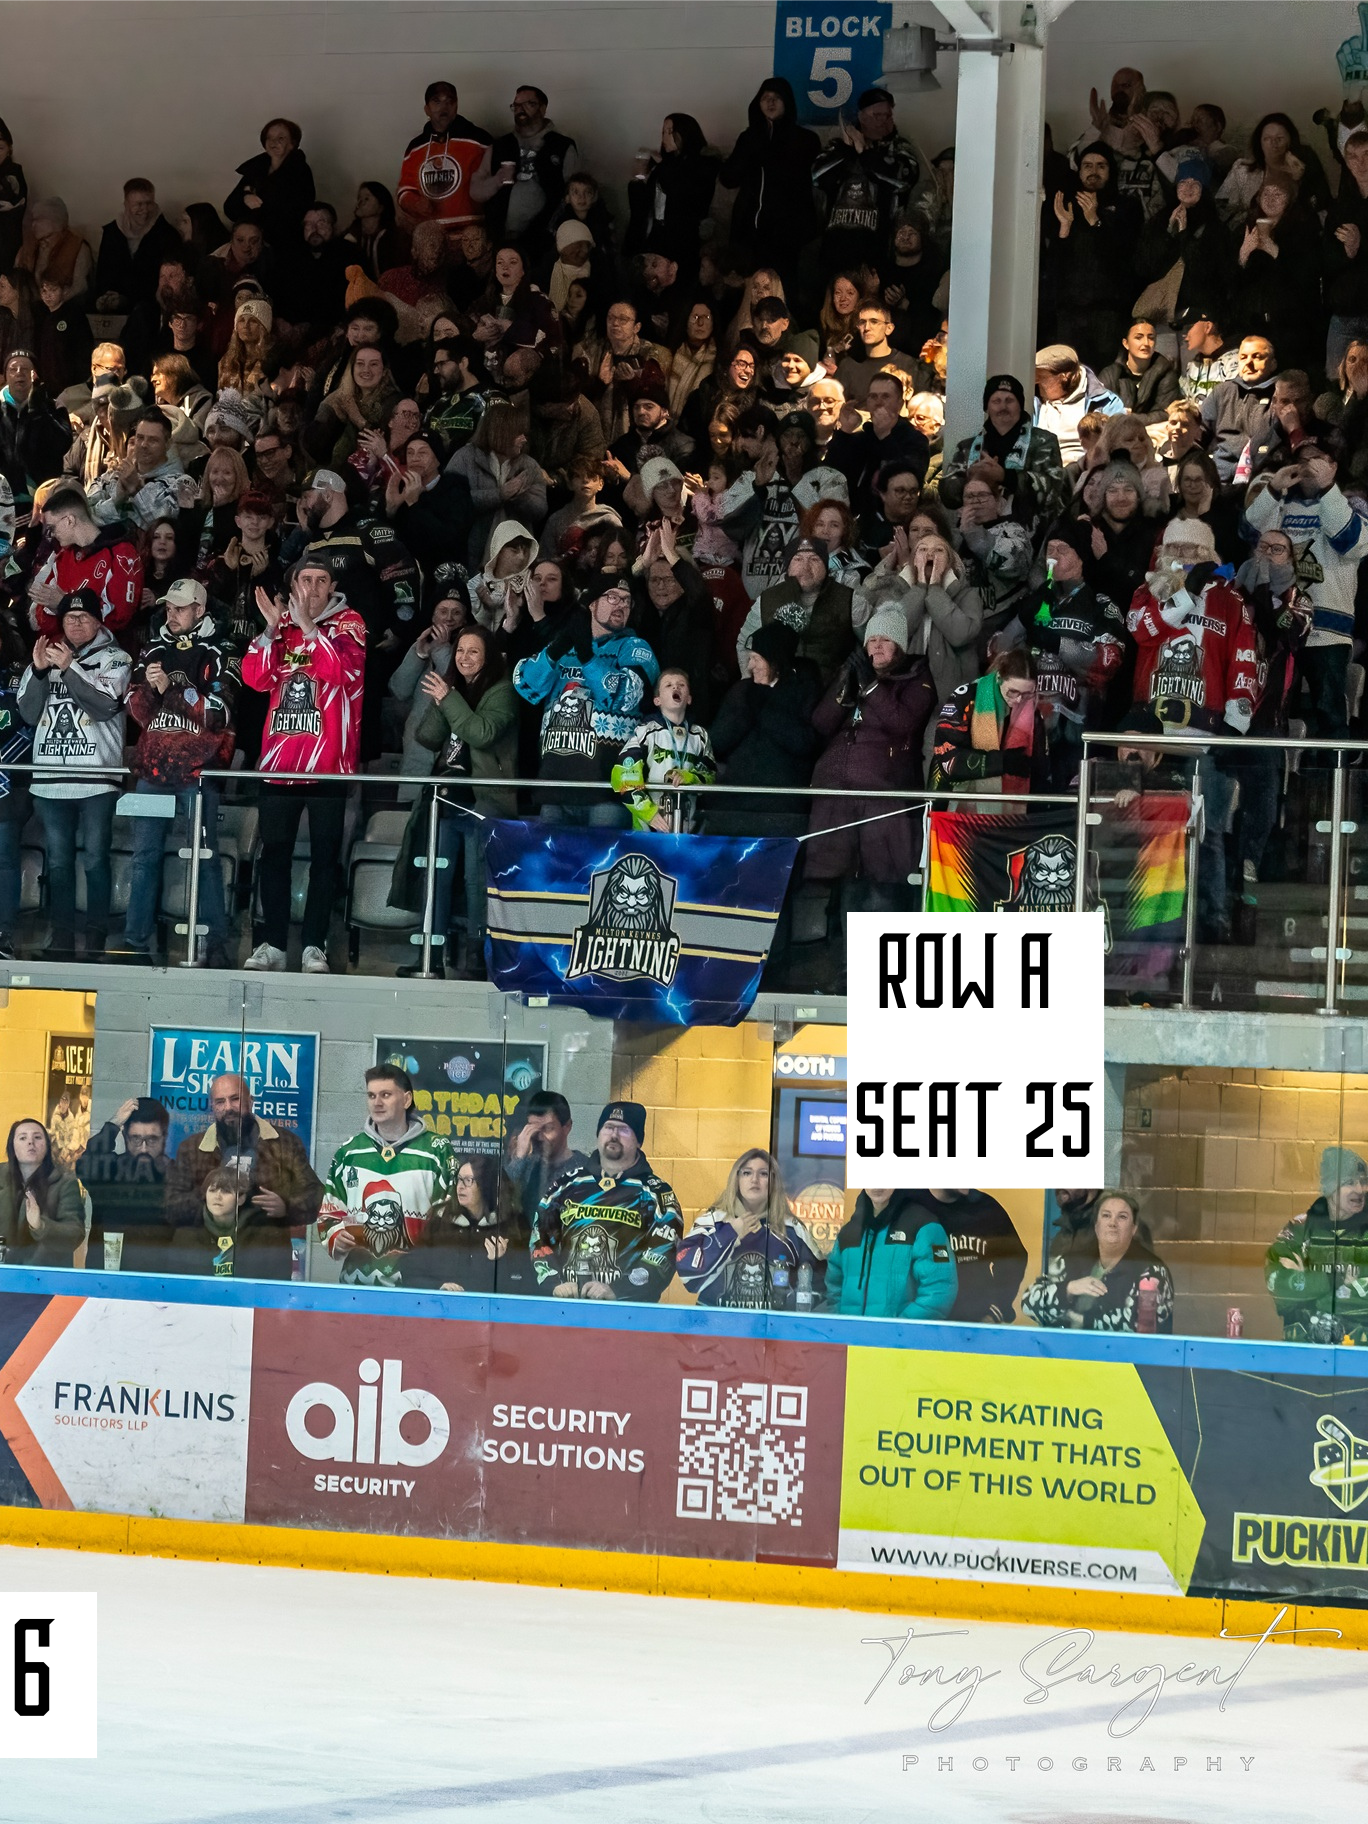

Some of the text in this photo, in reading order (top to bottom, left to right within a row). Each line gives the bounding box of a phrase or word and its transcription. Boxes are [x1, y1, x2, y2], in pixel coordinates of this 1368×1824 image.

[784, 16, 882, 39] BLOCK
[806, 47, 854, 109] 5
[1150, 674, 1205, 706] LIGHTNING
[38, 743, 97, 756] LIGHTNING
[595, 927, 662, 940] MILTON KEYNES
[568, 930, 679, 985] LIGHTNING
[161, 1037, 302, 1089] LEARN to
[774, 1055, 836, 1077] OOTH
[252, 1101, 299, 1117] FREE
[413, 1089, 520, 1115] RTHDAY
[422, 1113, 508, 1138] ARTIES
[577, 1206, 642, 1226] PUCKIVERSE
[54, 1381, 236, 1422] FRANKLINS
[285, 1358, 451, 1468] aib
[917, 1397, 1104, 1430] FOR SKATING
[54, 1414, 148, 1432] SOLICITORS LLP
[492, 1403, 632, 1437] SECURITY
[483, 1439, 646, 1474] SOLUTIONS
[876, 1430, 1142, 1469] EQUIPMENT THATS
[313, 1474, 416, 1498] SECURITY
[858, 1464, 1157, 1506] OUT OF THIS WORLD
[1239, 1518, 1368, 1566] PUCKIV
[870, 1546, 1138, 1582] WWW.PUCKIVERSE.COM
